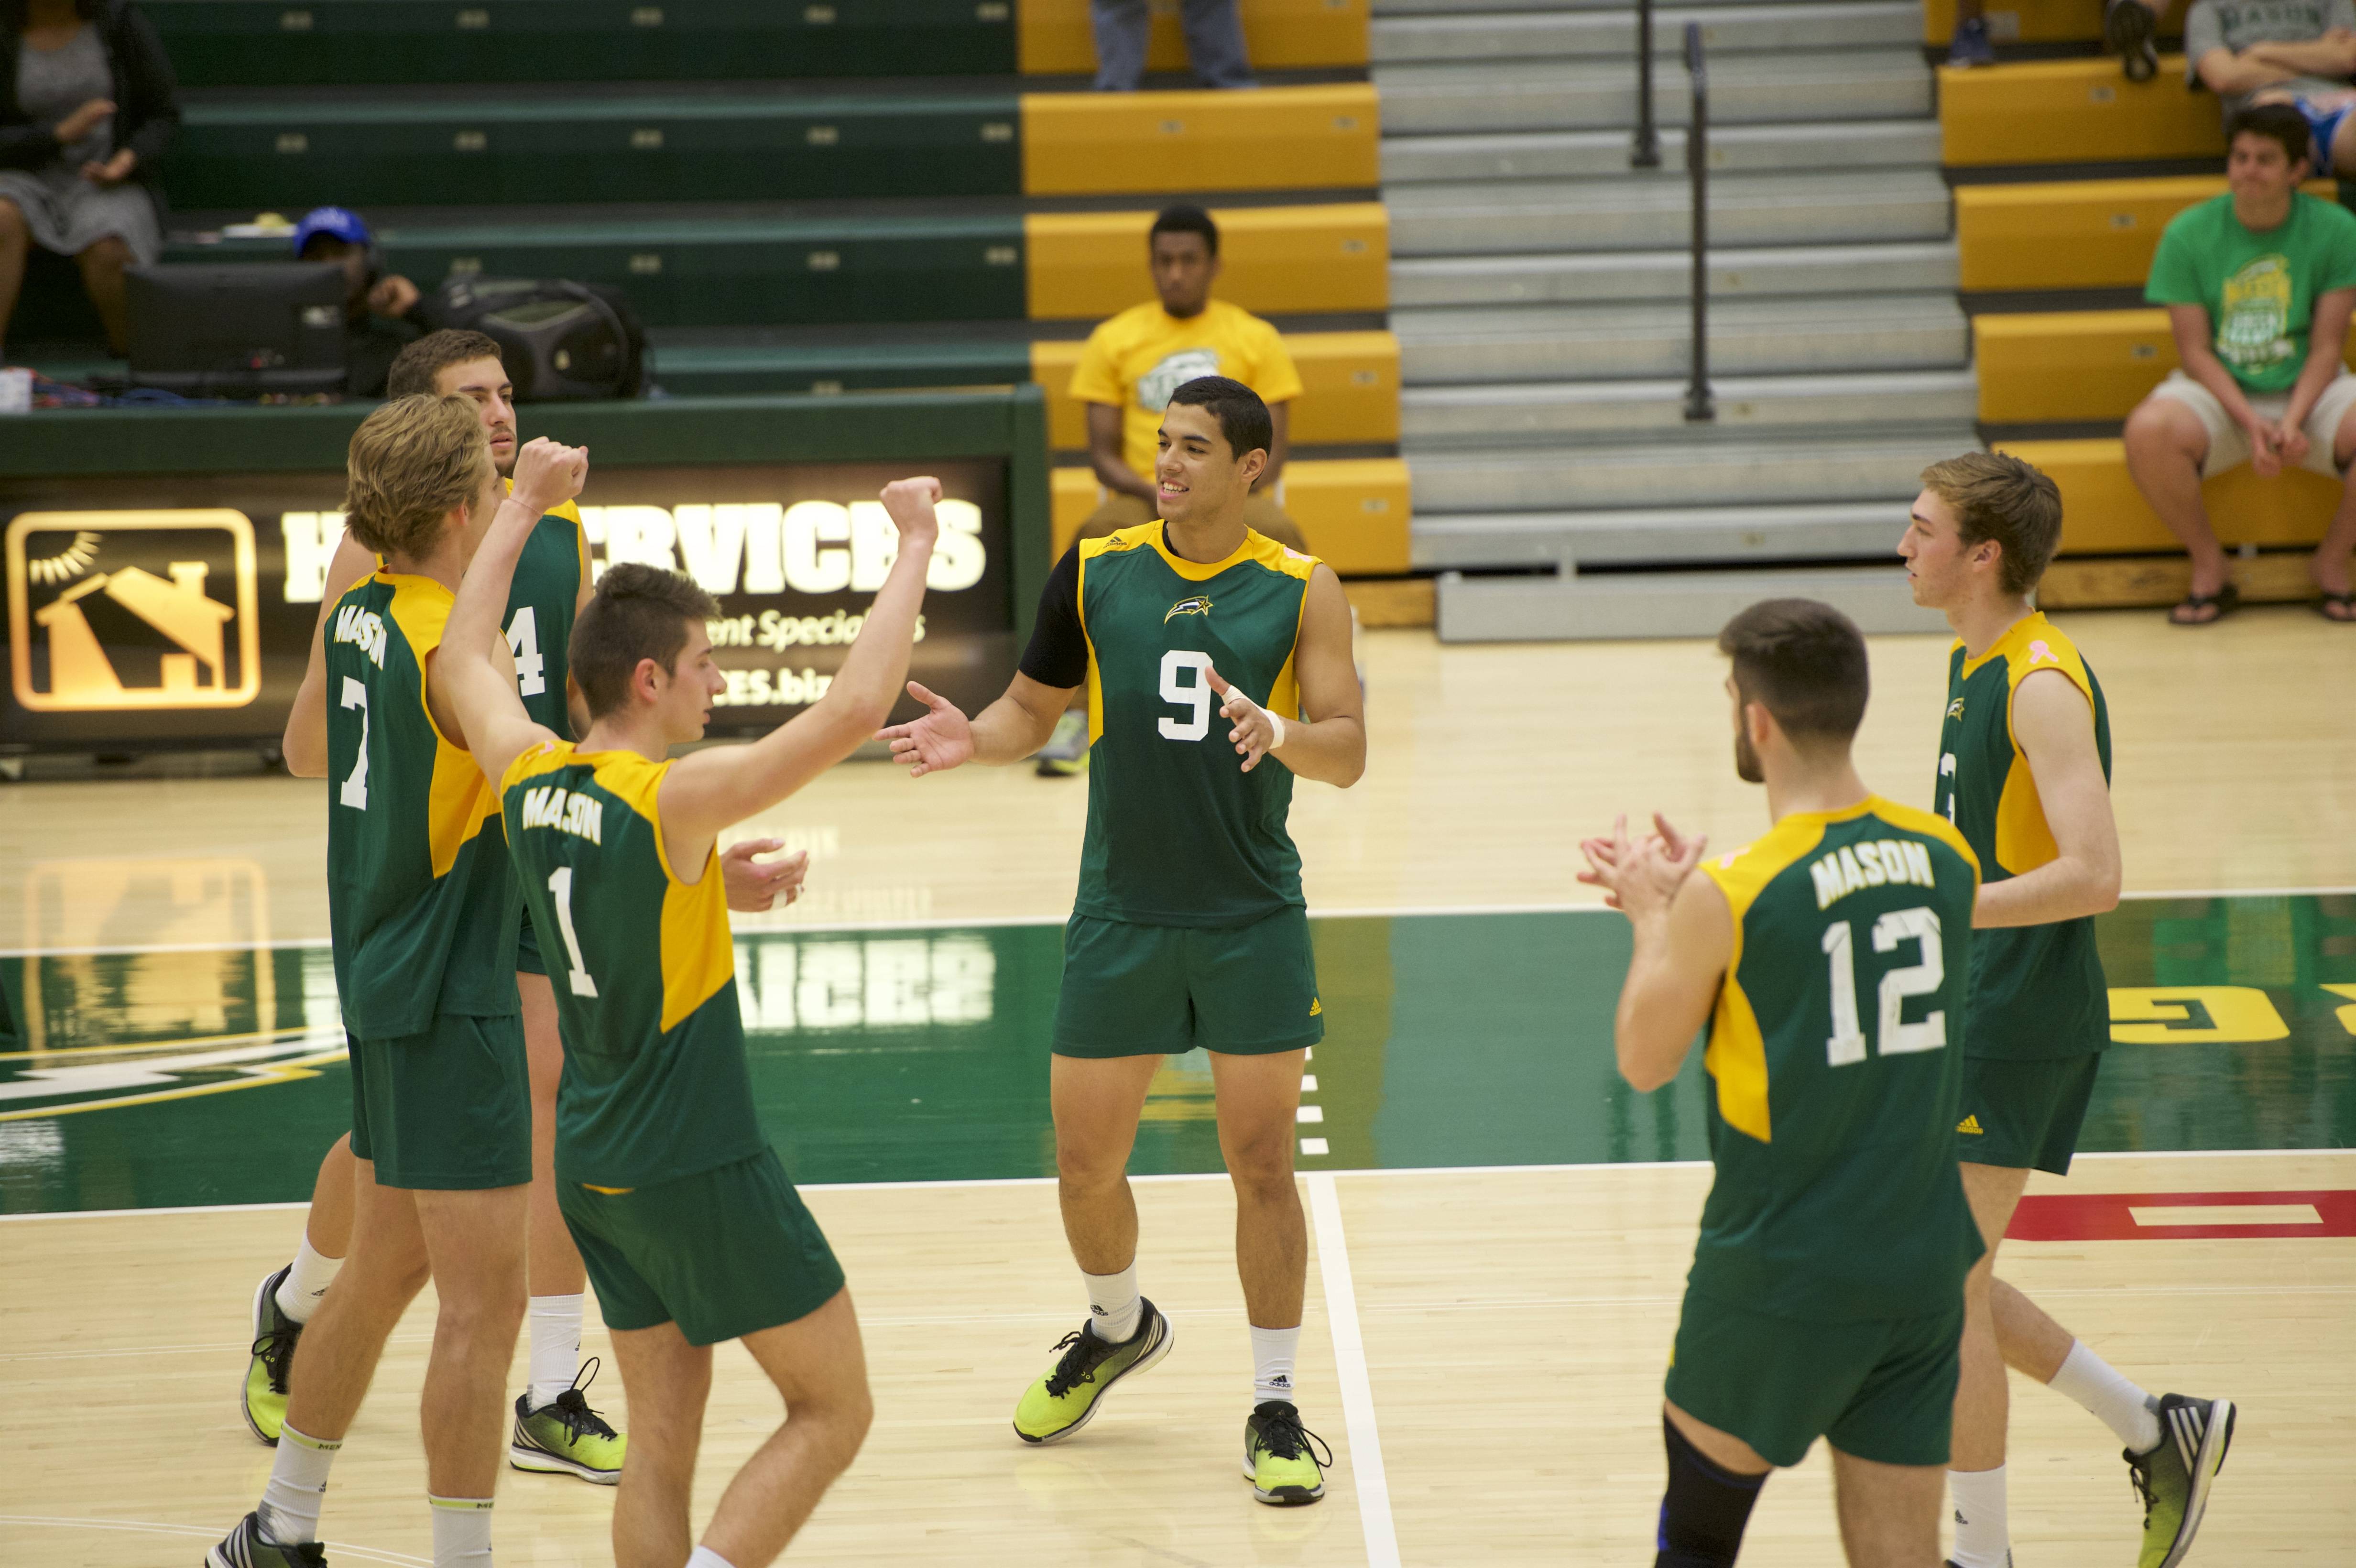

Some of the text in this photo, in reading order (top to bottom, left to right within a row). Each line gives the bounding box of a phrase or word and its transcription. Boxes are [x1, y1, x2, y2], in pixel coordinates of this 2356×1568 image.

[1103, 540, 1127, 549] adidas
[334, 604, 388, 671] MASN
[505, 605, 545, 697] 4
[1157, 650, 1213, 741] 9
[340, 675, 369, 811] 7
[1810, 839, 1935, 911] MASON
[548, 866, 599, 998] 1
[1822, 906, 1947, 1067] 12
